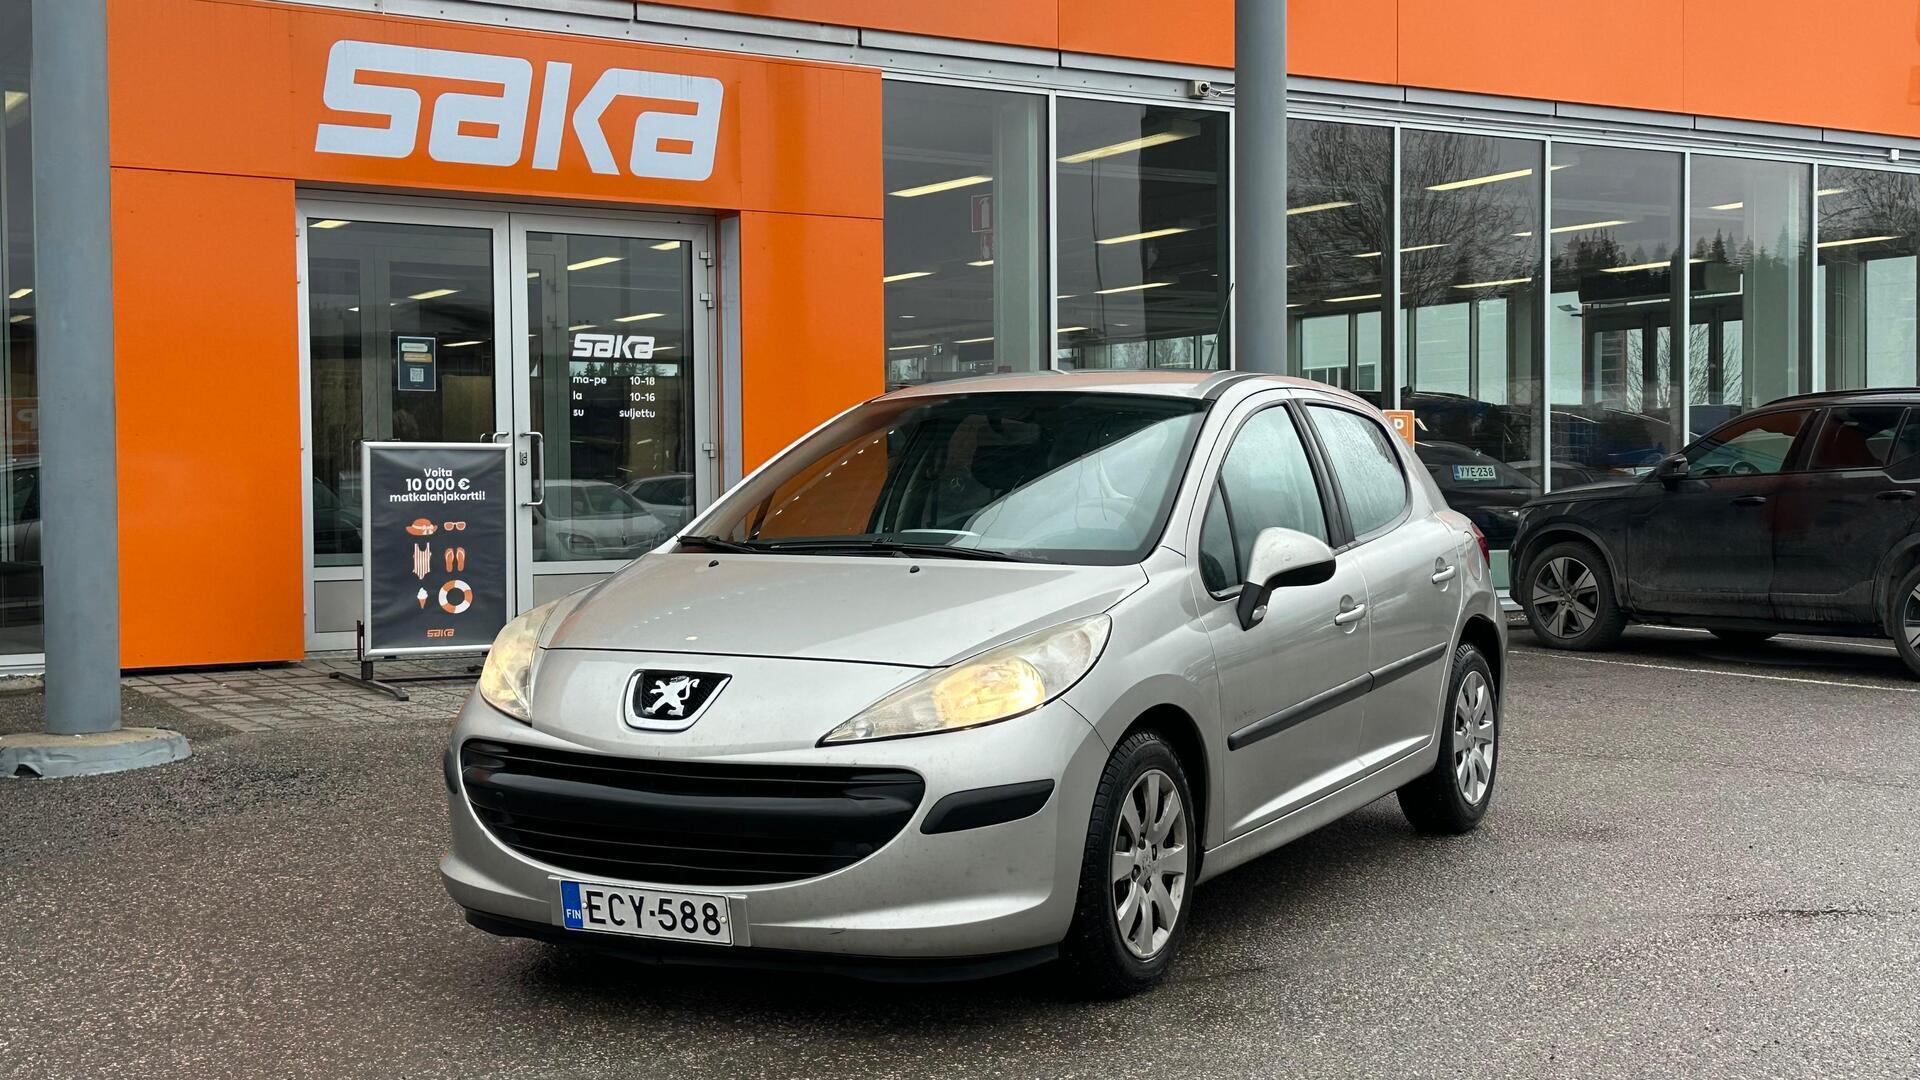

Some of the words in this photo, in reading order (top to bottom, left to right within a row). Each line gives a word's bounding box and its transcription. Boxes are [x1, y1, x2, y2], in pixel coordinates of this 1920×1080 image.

[573, 376, 607, 386] ma-pe
[630, 377, 656, 386] 10-18
[573, 390, 583, 400] la
[630, 393, 656, 402] 10-16
[573, 409, 584, 417] su
[619, 408, 656, 419] suljettu
[423, 467, 453, 478] Voita
[1459, 467, 1494, 477] YYE-238
[405, 478, 422, 491] 10
[425, 478, 455, 491] 000
[457, 478, 471, 490] €
[390, 491, 485, 504] matkalahjakortti!
[566, 908, 582, 921] FIN
